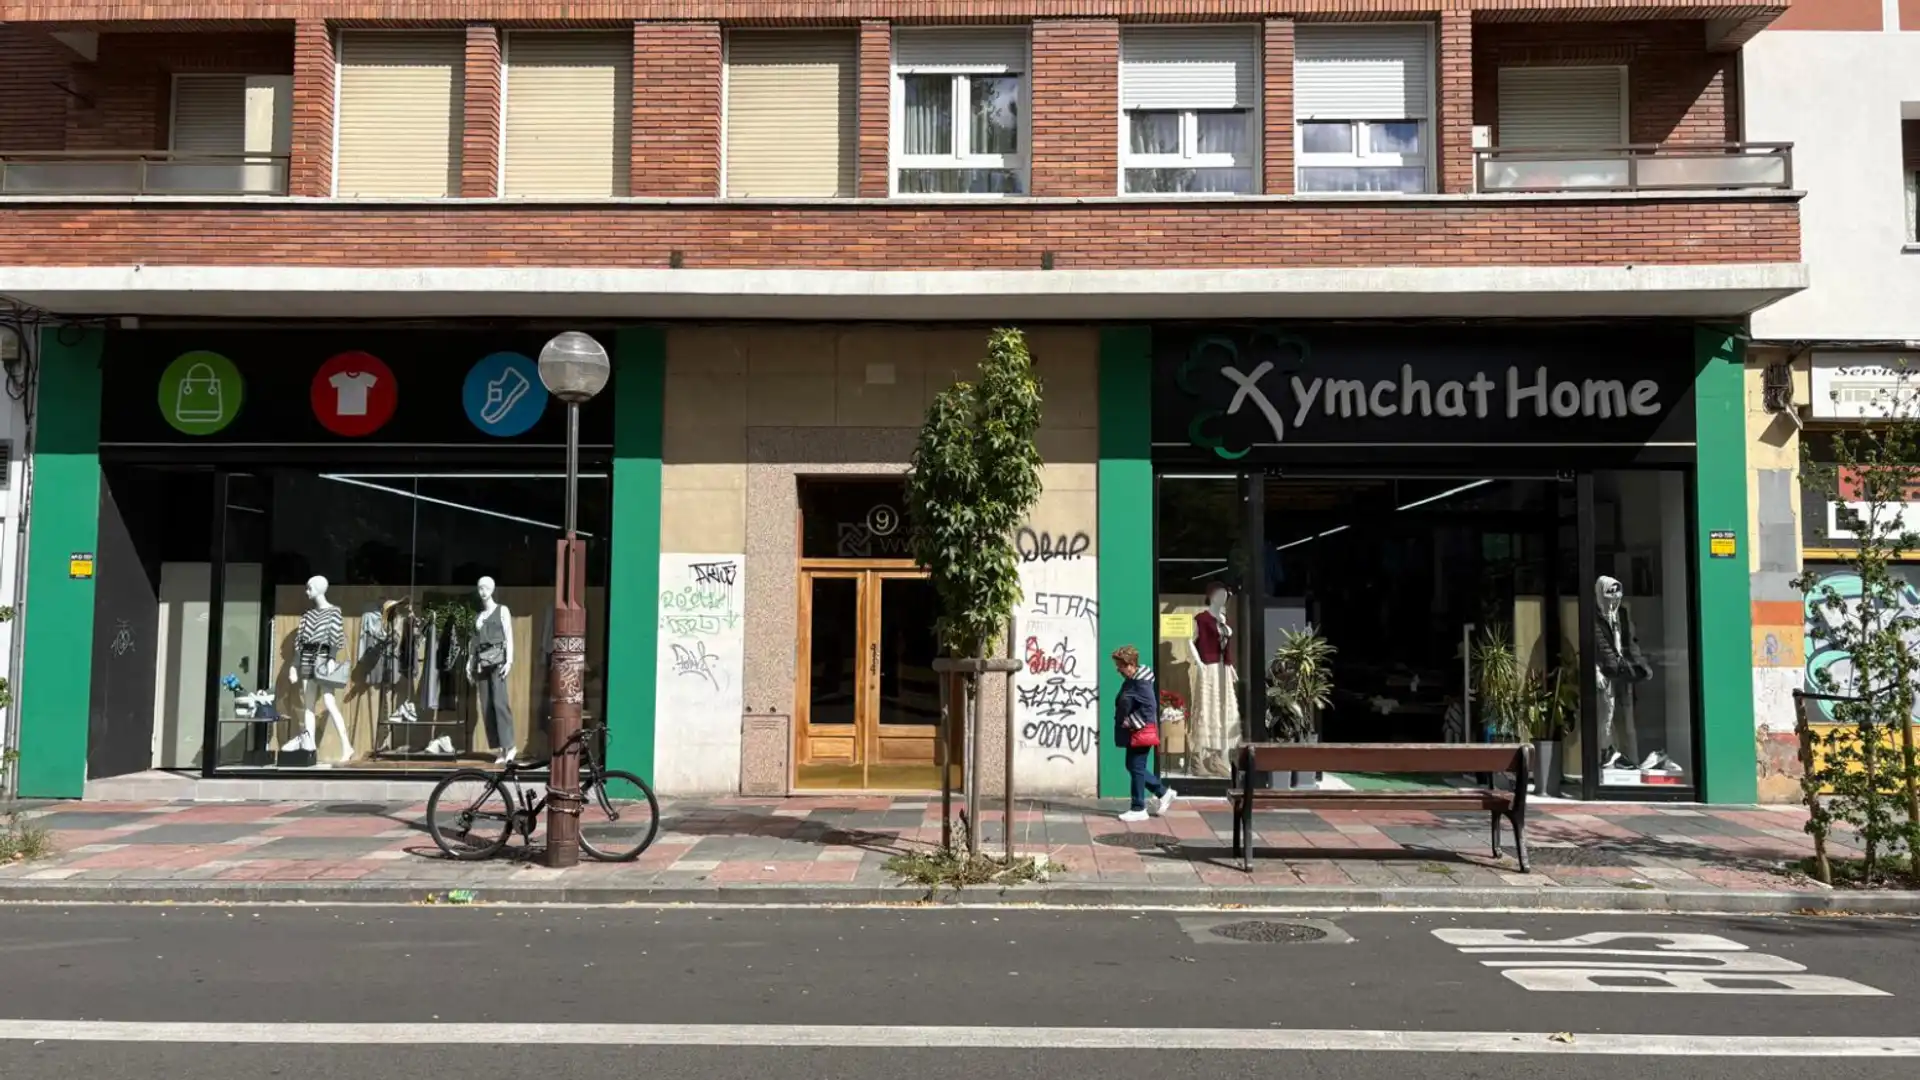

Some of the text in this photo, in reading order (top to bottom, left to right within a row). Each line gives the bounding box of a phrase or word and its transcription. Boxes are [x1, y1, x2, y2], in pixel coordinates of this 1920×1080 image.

[1220, 361, 1662, 441] Xymchat Home
[876, 509, 890, 530] 9
[1431, 928, 1896, 996] BUS
